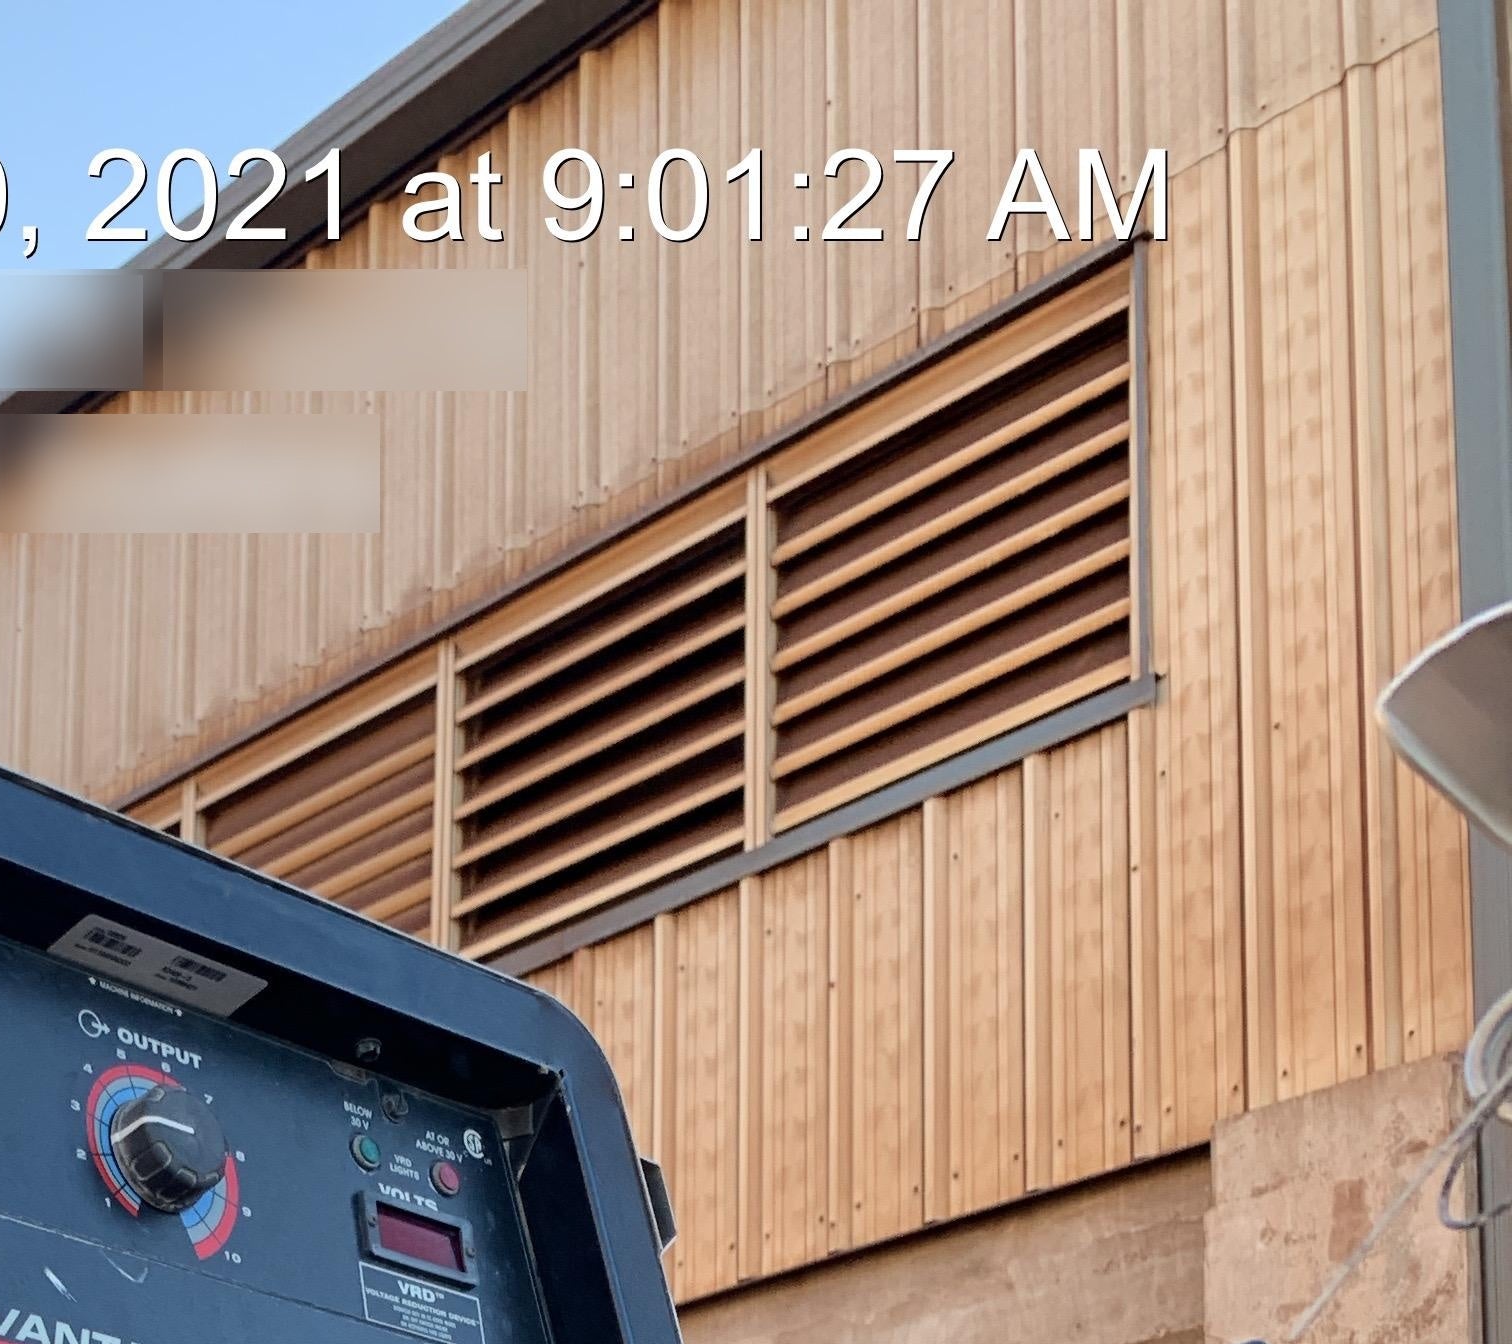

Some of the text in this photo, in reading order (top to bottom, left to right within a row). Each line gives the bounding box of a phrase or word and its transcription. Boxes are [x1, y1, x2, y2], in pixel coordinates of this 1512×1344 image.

[117, 1027, 202, 1070] OUTPUT
[343, 1101, 372, 1119] BELOW
[416, 1139, 444, 1159] ABOVE
[389, 1163, 420, 1181] LIGHTS
[224, 1250, 242, 1264] 10
